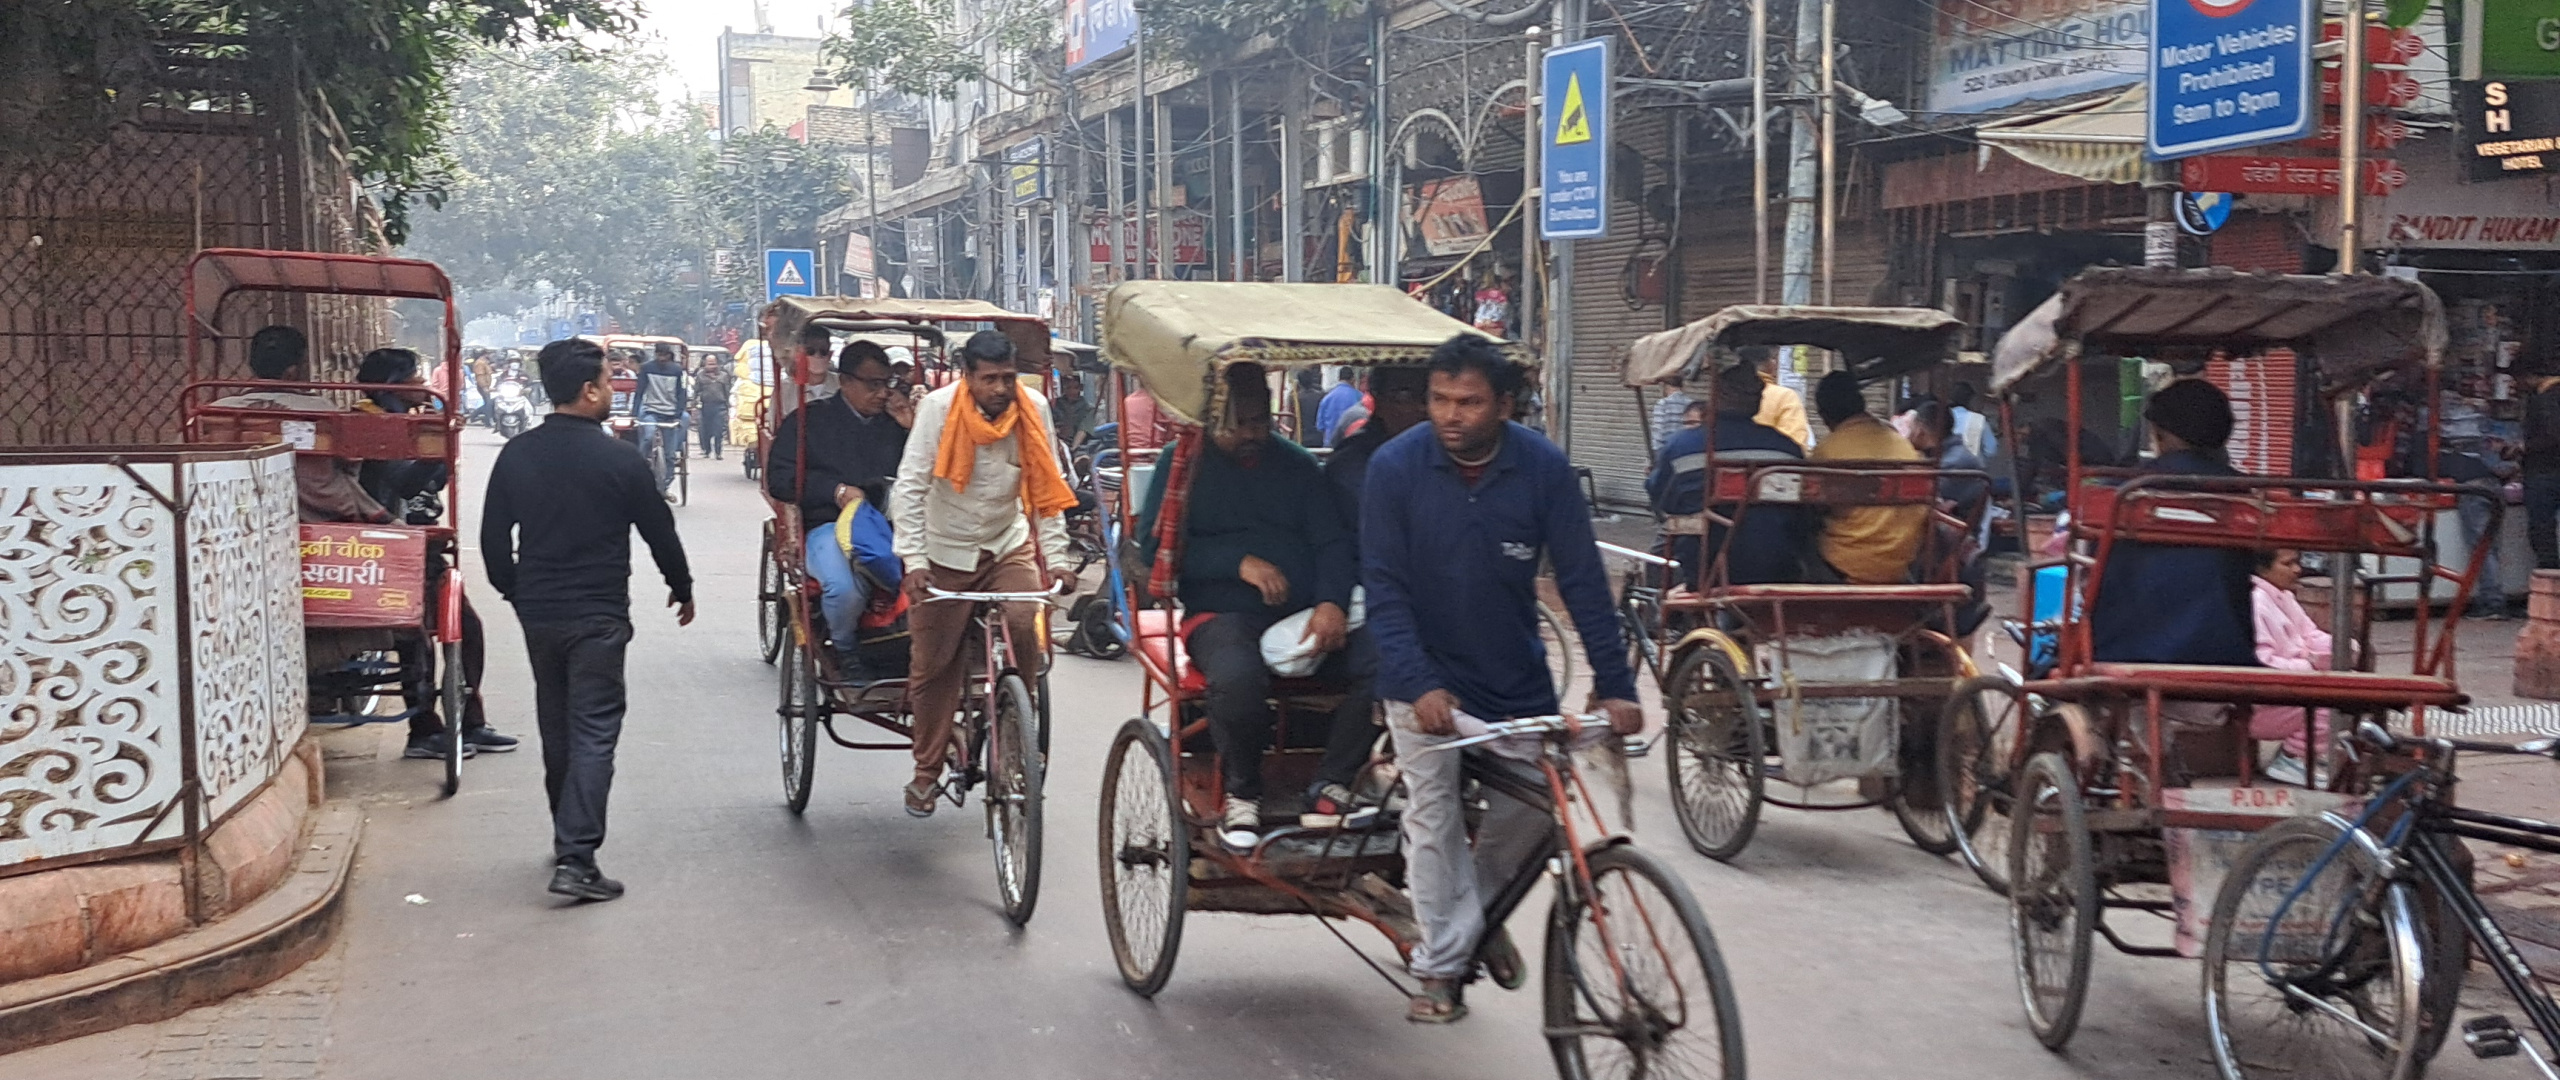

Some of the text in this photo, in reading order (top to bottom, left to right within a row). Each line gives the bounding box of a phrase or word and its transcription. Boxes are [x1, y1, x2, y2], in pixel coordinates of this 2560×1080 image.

[1951, 23, 2082, 73] MATTING
[2160, 42, 2215, 68] Motor
[2216, 24, 2297, 55] Vehicles
[2179, 55, 2275, 94] Prohibited
[2173, 91, 2281, 126] 9am to 9pm
[2475, 138, 2555, 157] VEGETARIAN
[2502, 155, 2544, 170] HOTEL
[1558, 170, 1588, 184] You are
[1549, 186, 1597, 203] under CCTV
[1549, 206, 1597, 222] Surveillance
[336, 535, 385, 559] चौक
[302, 559, 386, 586] सवारी!
